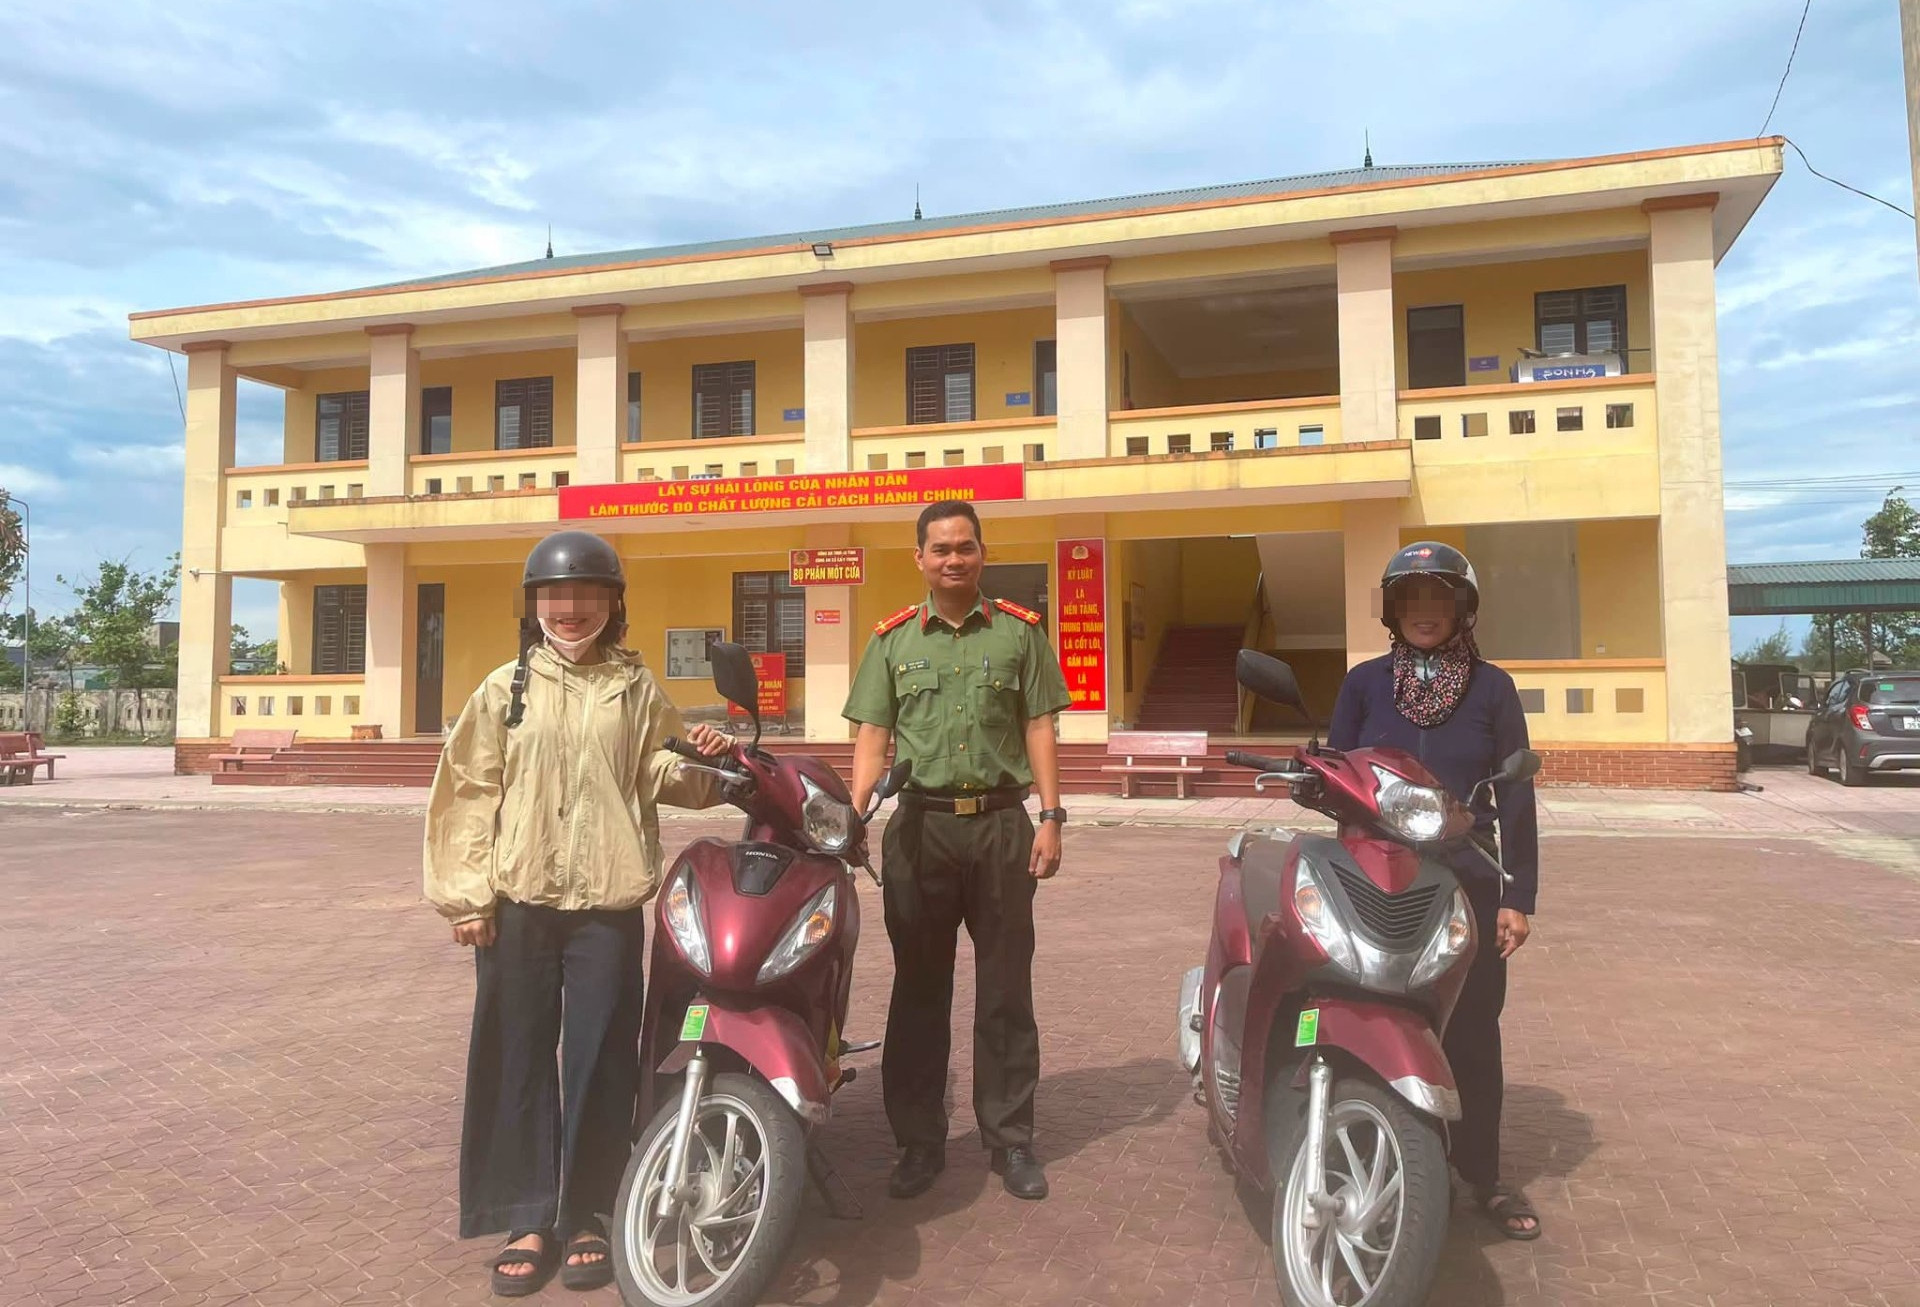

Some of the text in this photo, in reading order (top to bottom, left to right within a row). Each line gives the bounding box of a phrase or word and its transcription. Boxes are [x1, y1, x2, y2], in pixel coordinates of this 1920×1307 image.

[658, 472, 908, 497] LẤY SỰ HÀI LÒNG CỦA NHÂN DÂN
[590, 487, 975, 517] LÀM THƯỚC ĐO CHẤT LƯỢNG CẢI CÁCH HÀNH CHÍNH
[805, 565, 826, 582] PHẬN
[827, 564, 843, 581] MỘT
[745, 851, 778, 860] HONDA
